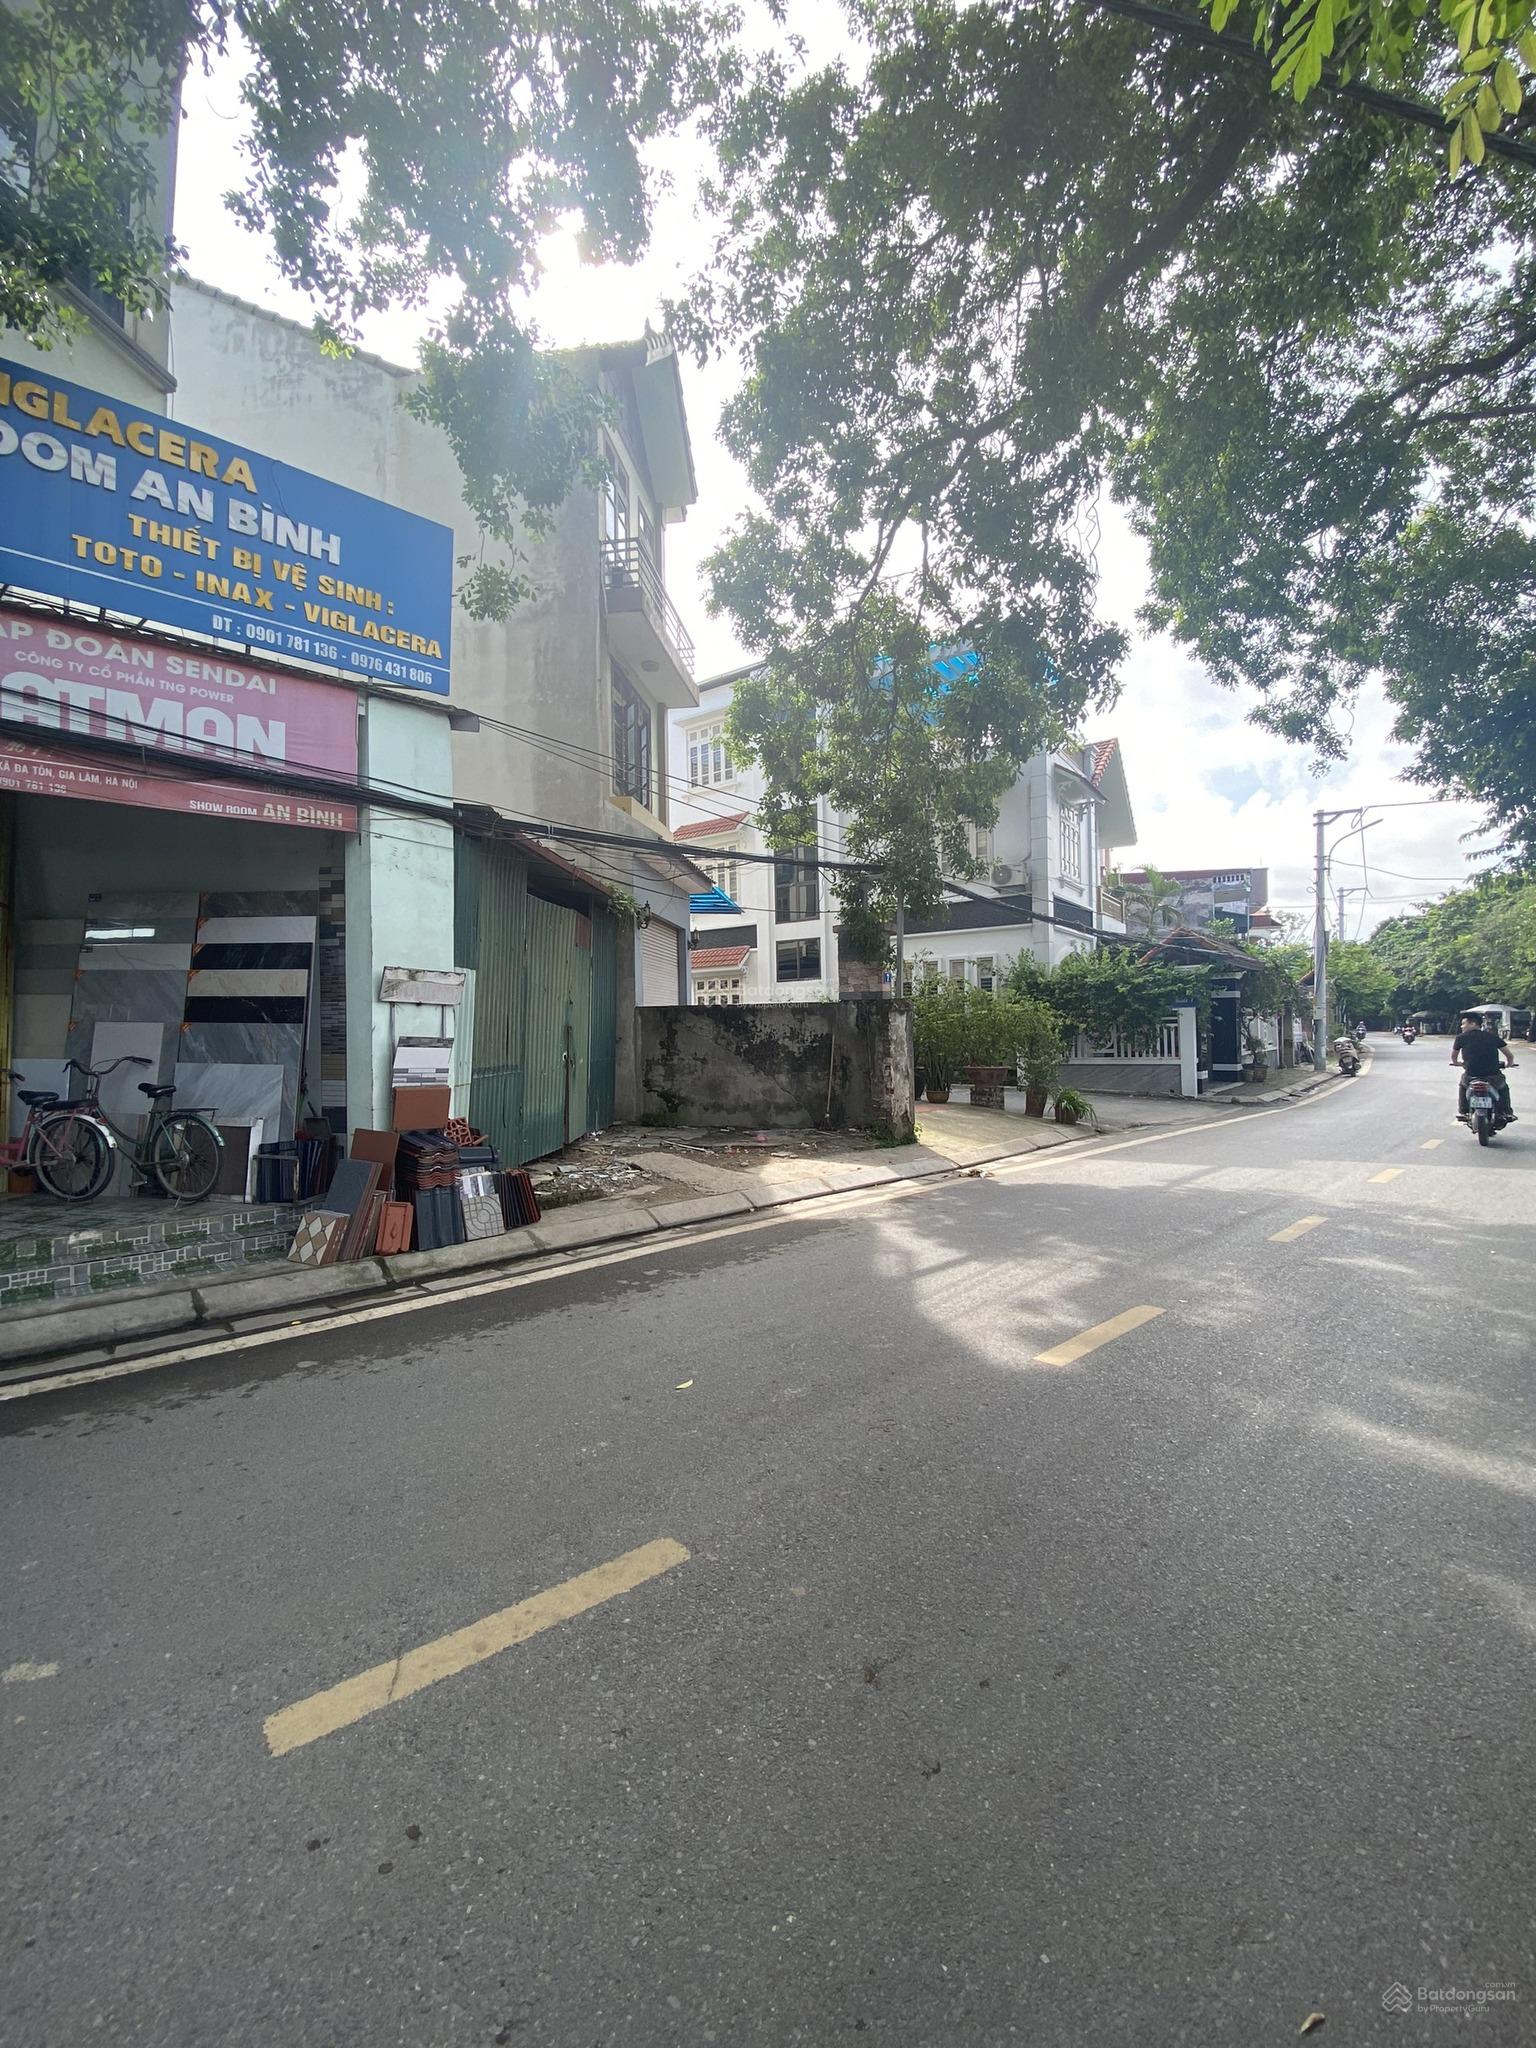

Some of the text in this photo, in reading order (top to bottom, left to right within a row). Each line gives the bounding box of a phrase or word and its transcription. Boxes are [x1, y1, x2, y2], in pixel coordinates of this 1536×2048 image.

[130, 468, 215, 524] AN
[228, 498, 342, 567] BÌNH
[128, 512, 222, 561] THIẾT
[232, 545, 262, 579] BỊ
[272, 559, 308, 592] VỆ
[317, 574, 382, 613] SINH
[71, 533, 443, 660] TOTO - INAX - VIGLACERA
[14, 650, 64, 670] CÔNG
[67, 660, 84, 674] TY
[88, 664, 112, 680] CỔ
[159, 679, 187, 694] TNG
[189, 686, 235, 704] POWER
[46, 628, 155, 670] ĐOÀN
[165, 655, 277, 696] SENDAI
[245, 623, 283, 646] 0901
[286, 633, 310, 654] 781
[313, 641, 338, 661] 136
[350, 651, 383, 672] 0976
[384, 661, 407, 679] 431
[409, 667, 433, 686] 806
[0, 776, 21, 788] 901
[58, 769, 76, 780] GIA
[189, 799, 344, 828] SHOW ROOM AN BÌNH
